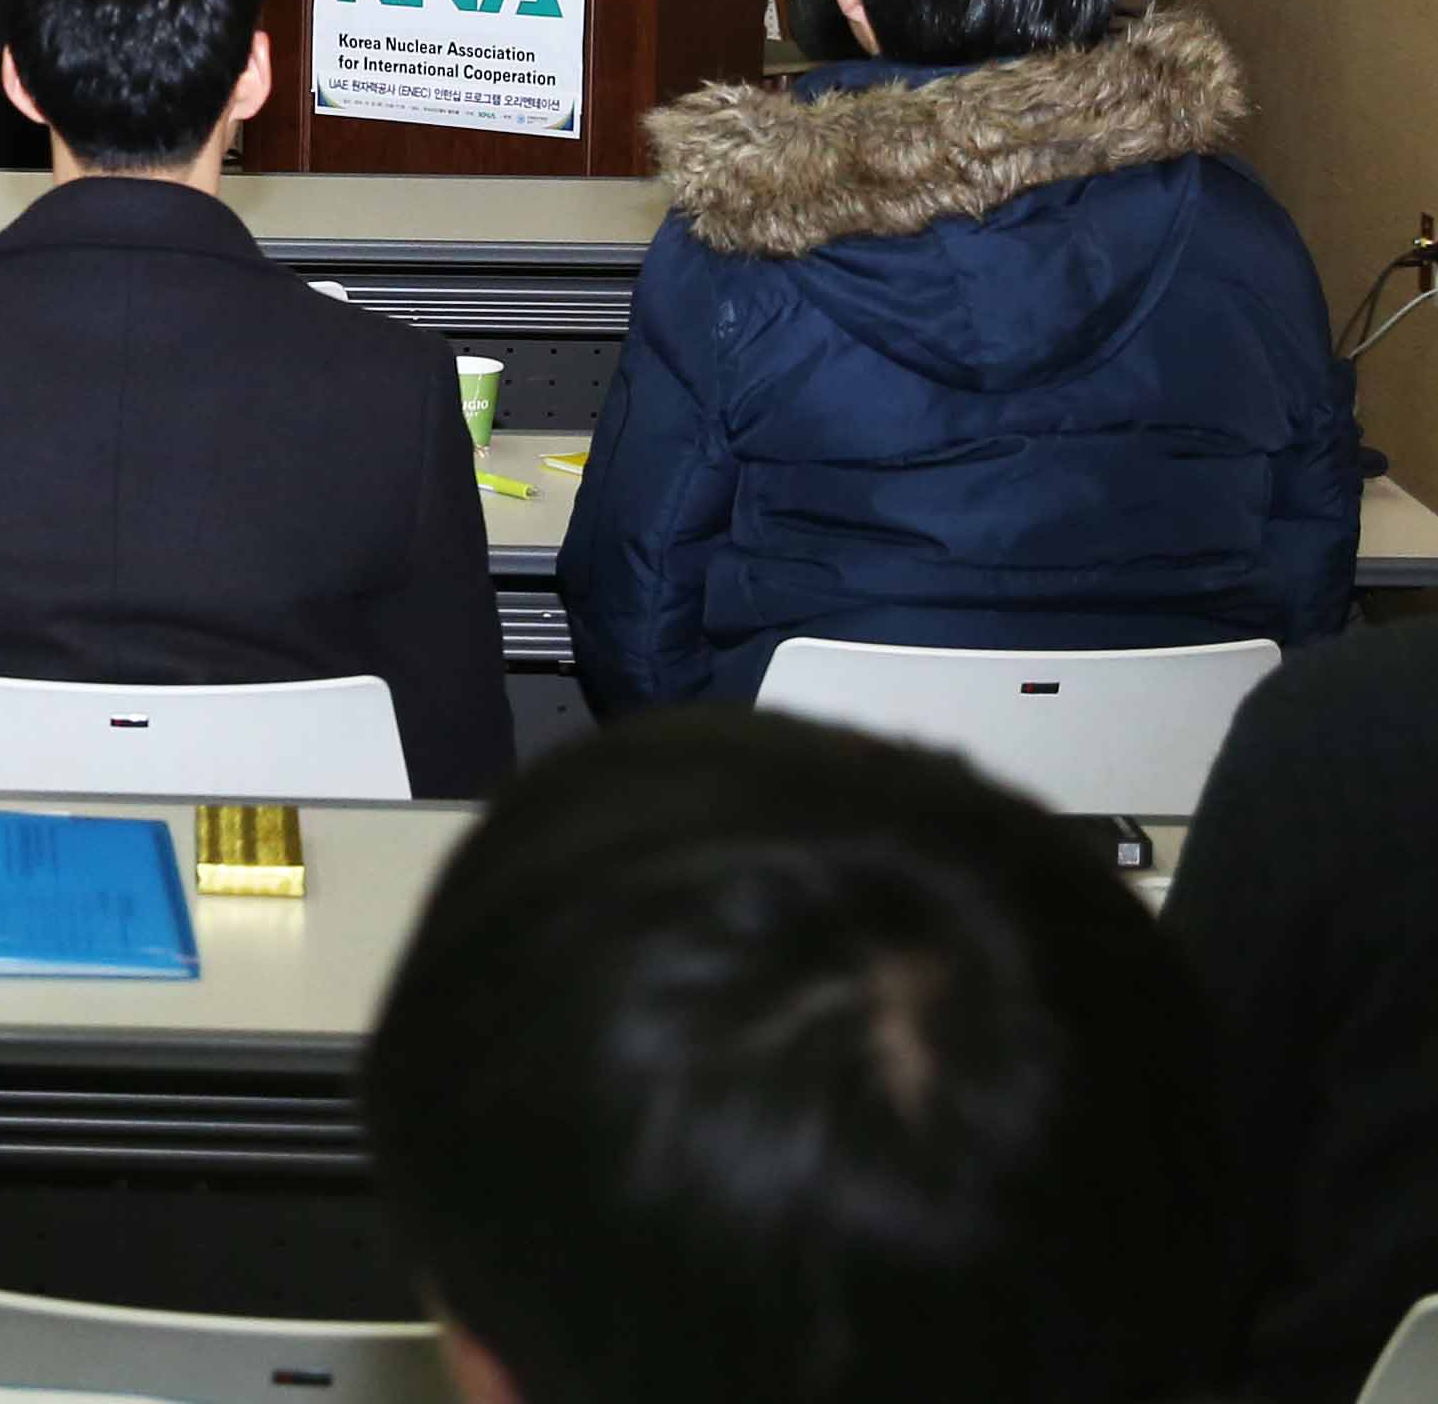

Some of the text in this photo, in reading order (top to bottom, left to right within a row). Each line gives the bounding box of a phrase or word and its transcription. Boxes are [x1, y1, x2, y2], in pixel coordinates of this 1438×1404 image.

[339, 33, 535, 63] Korea Nuclear Association
[338, 54, 556, 86] for International Cooperation
